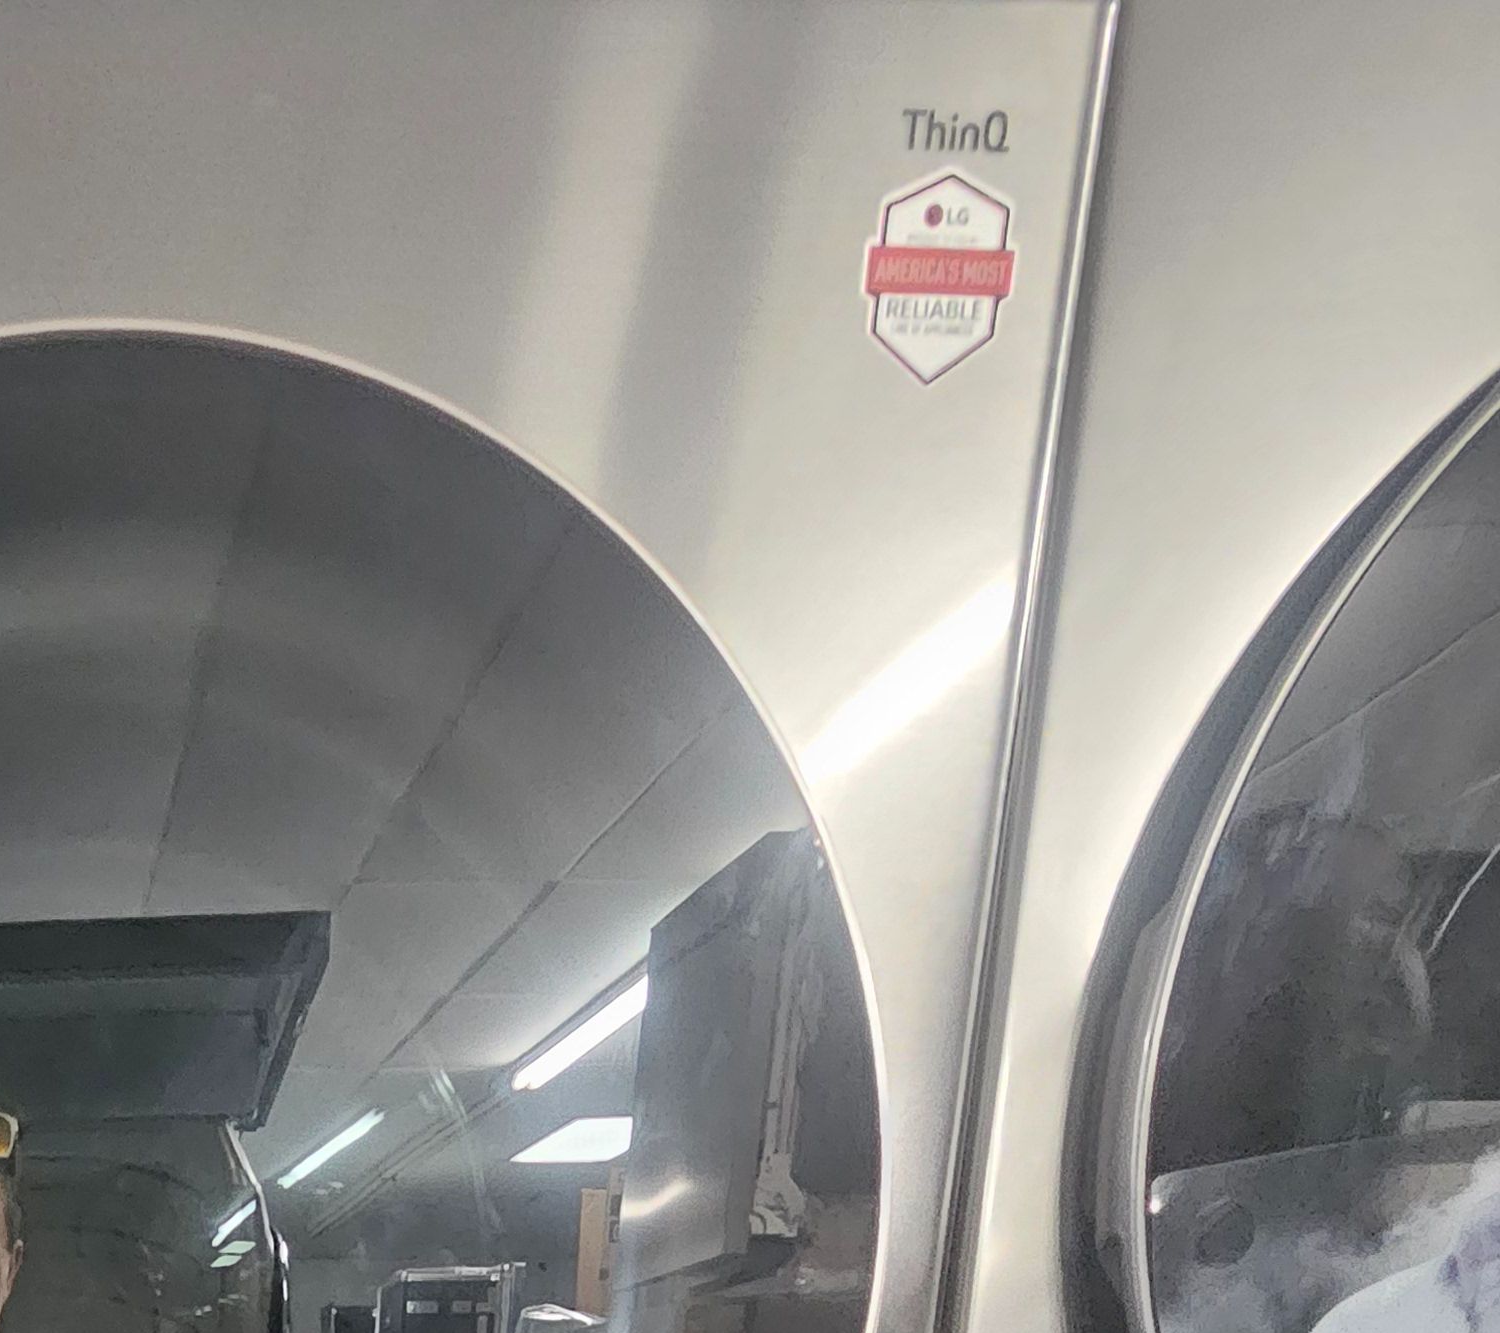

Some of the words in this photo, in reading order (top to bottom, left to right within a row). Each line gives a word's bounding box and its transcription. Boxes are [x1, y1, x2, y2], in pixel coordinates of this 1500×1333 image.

[902, 108, 1010, 153] ThinQ
[873, 255, 962, 285] AMERICA'S
[962, 258, 1008, 288] MOST
[884, 297, 982, 322] RELIABLE
